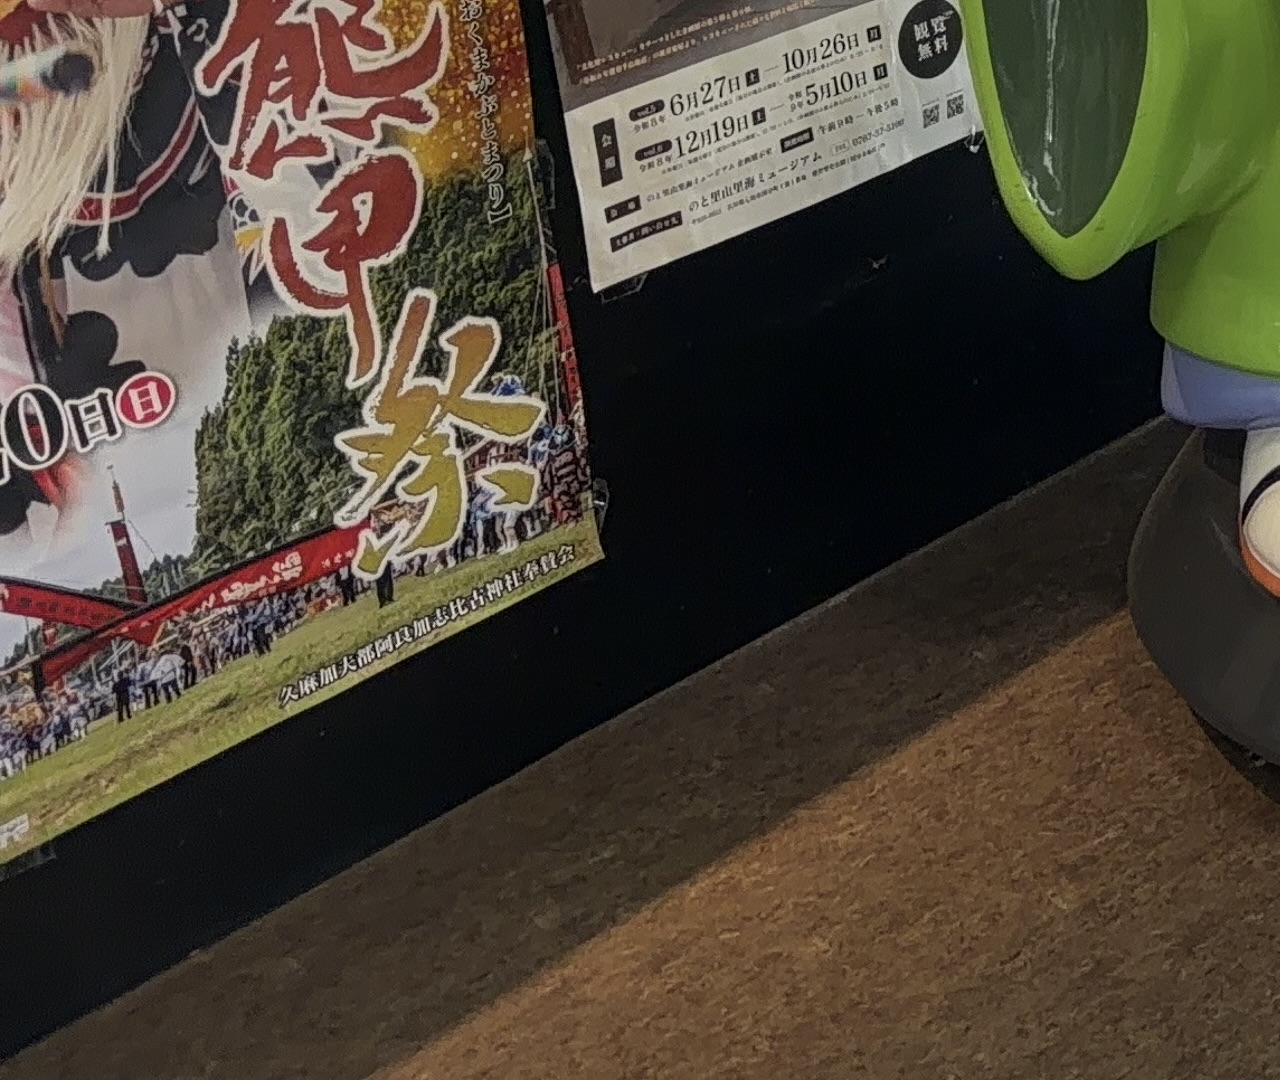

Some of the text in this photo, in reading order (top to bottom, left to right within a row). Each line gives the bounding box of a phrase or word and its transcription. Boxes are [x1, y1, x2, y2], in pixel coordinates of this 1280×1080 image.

[669, 75, 741, 117] 6月27日
[781, 33, 860, 74] 10月26日
[805, 72, 867, 106] 5月10日
[674, 114, 749, 159] 12月19日
[0, 384, 121, 480] 0日
